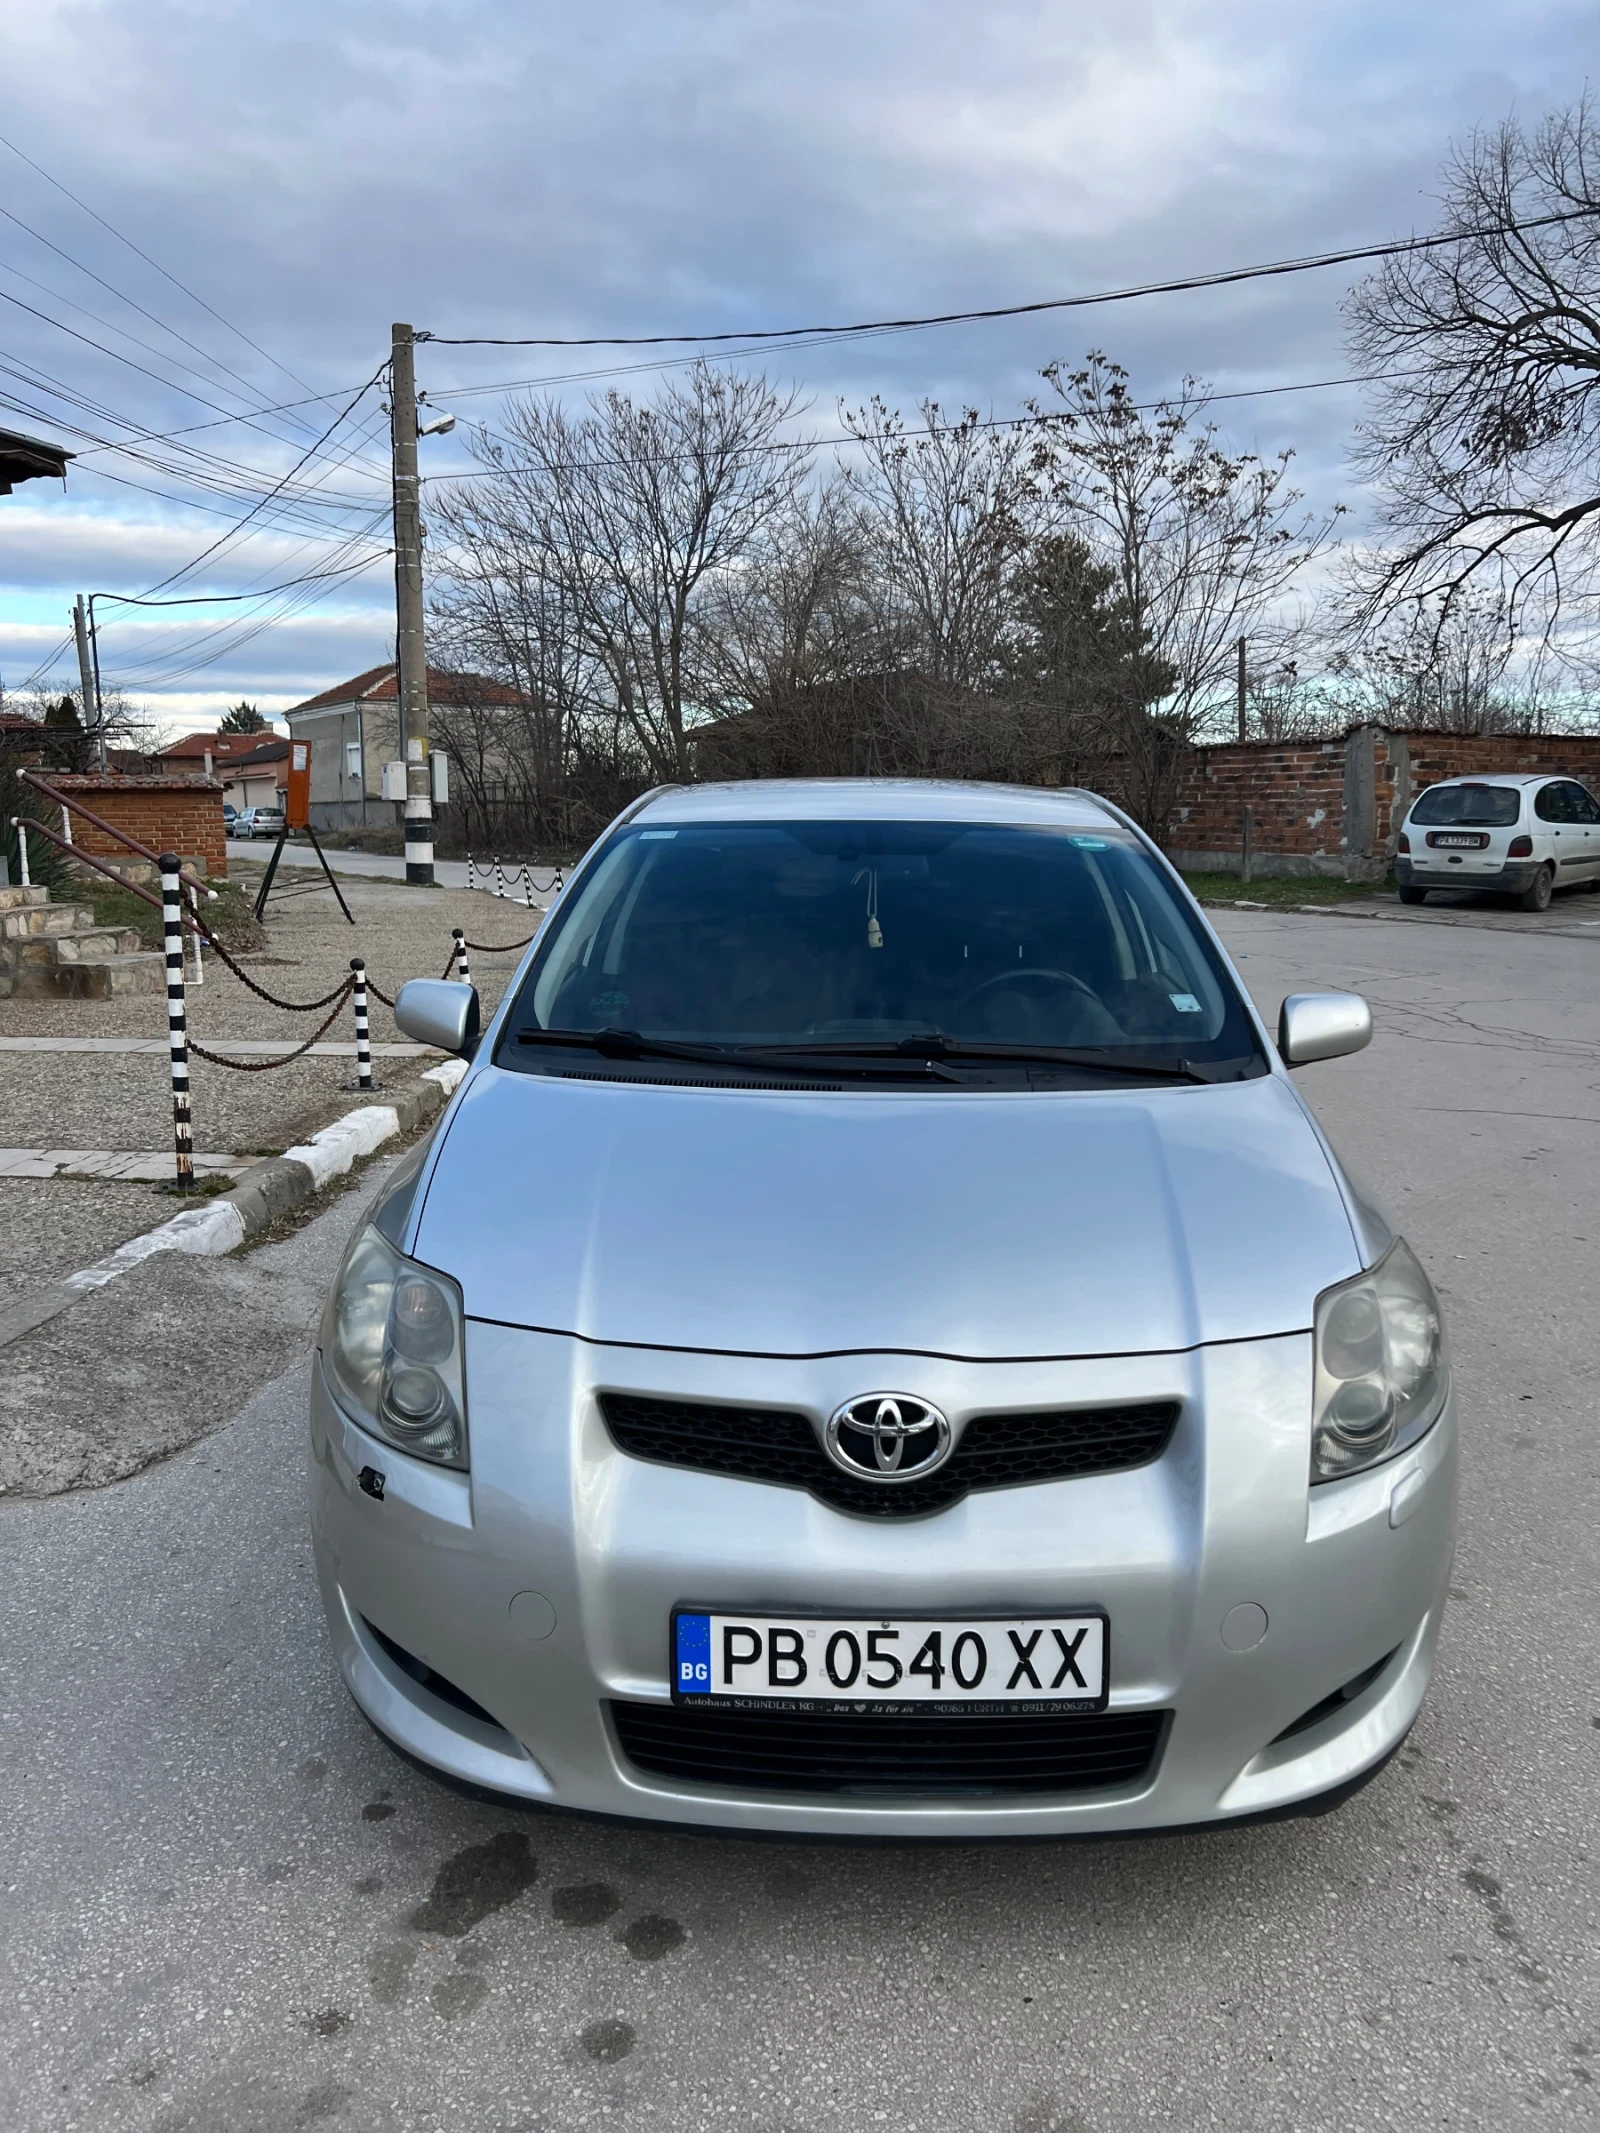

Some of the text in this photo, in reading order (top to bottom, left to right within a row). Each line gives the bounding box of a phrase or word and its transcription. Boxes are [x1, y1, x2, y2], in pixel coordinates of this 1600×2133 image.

[723, 1625, 1089, 1690] PB 0540 XX
[681, 1662, 708, 1681] BG
[684, 1696, 731, 1708] Autohaus
[734, 1698, 796, 1710] SCHINDLER
[799, 1701, 815, 1711] KG
